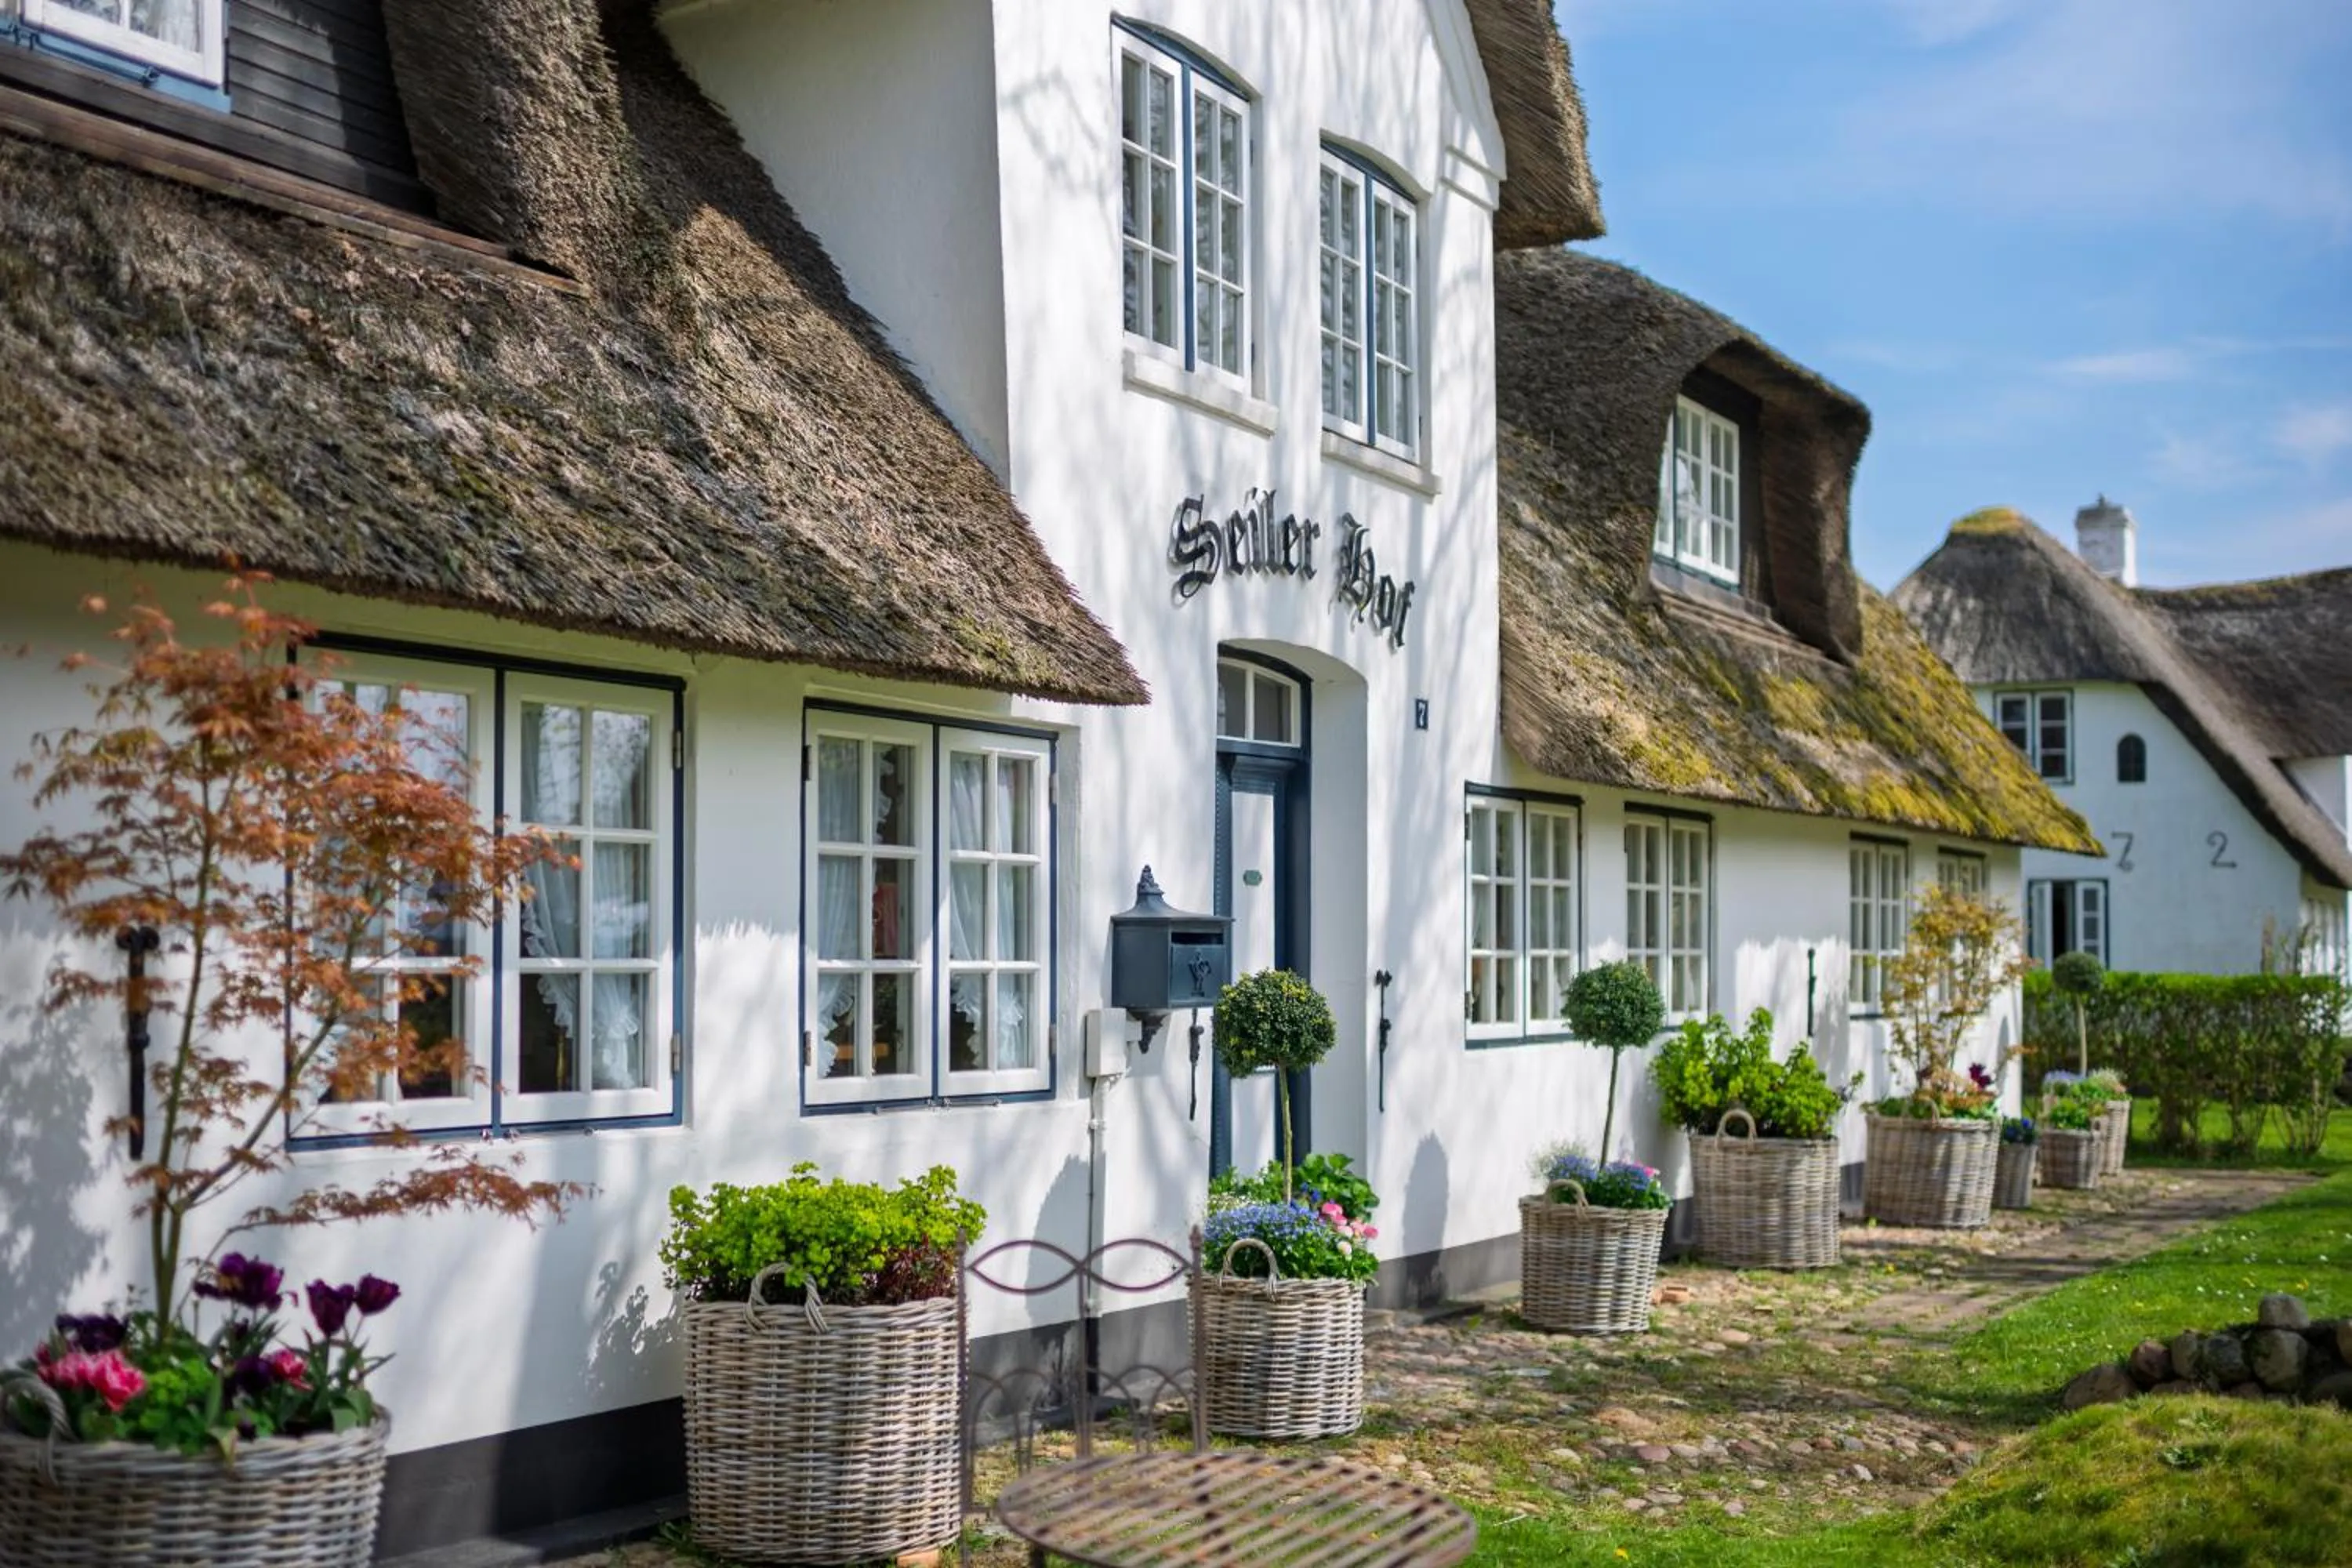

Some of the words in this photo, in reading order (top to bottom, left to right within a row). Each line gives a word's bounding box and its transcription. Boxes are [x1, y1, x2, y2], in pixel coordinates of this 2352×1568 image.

[1175, 487, 1321, 598] Seiler
[1338, 512, 1416, 648] Hof
[1418, 702, 1426, 726] 7
[2206, 829, 2238, 869] 2
